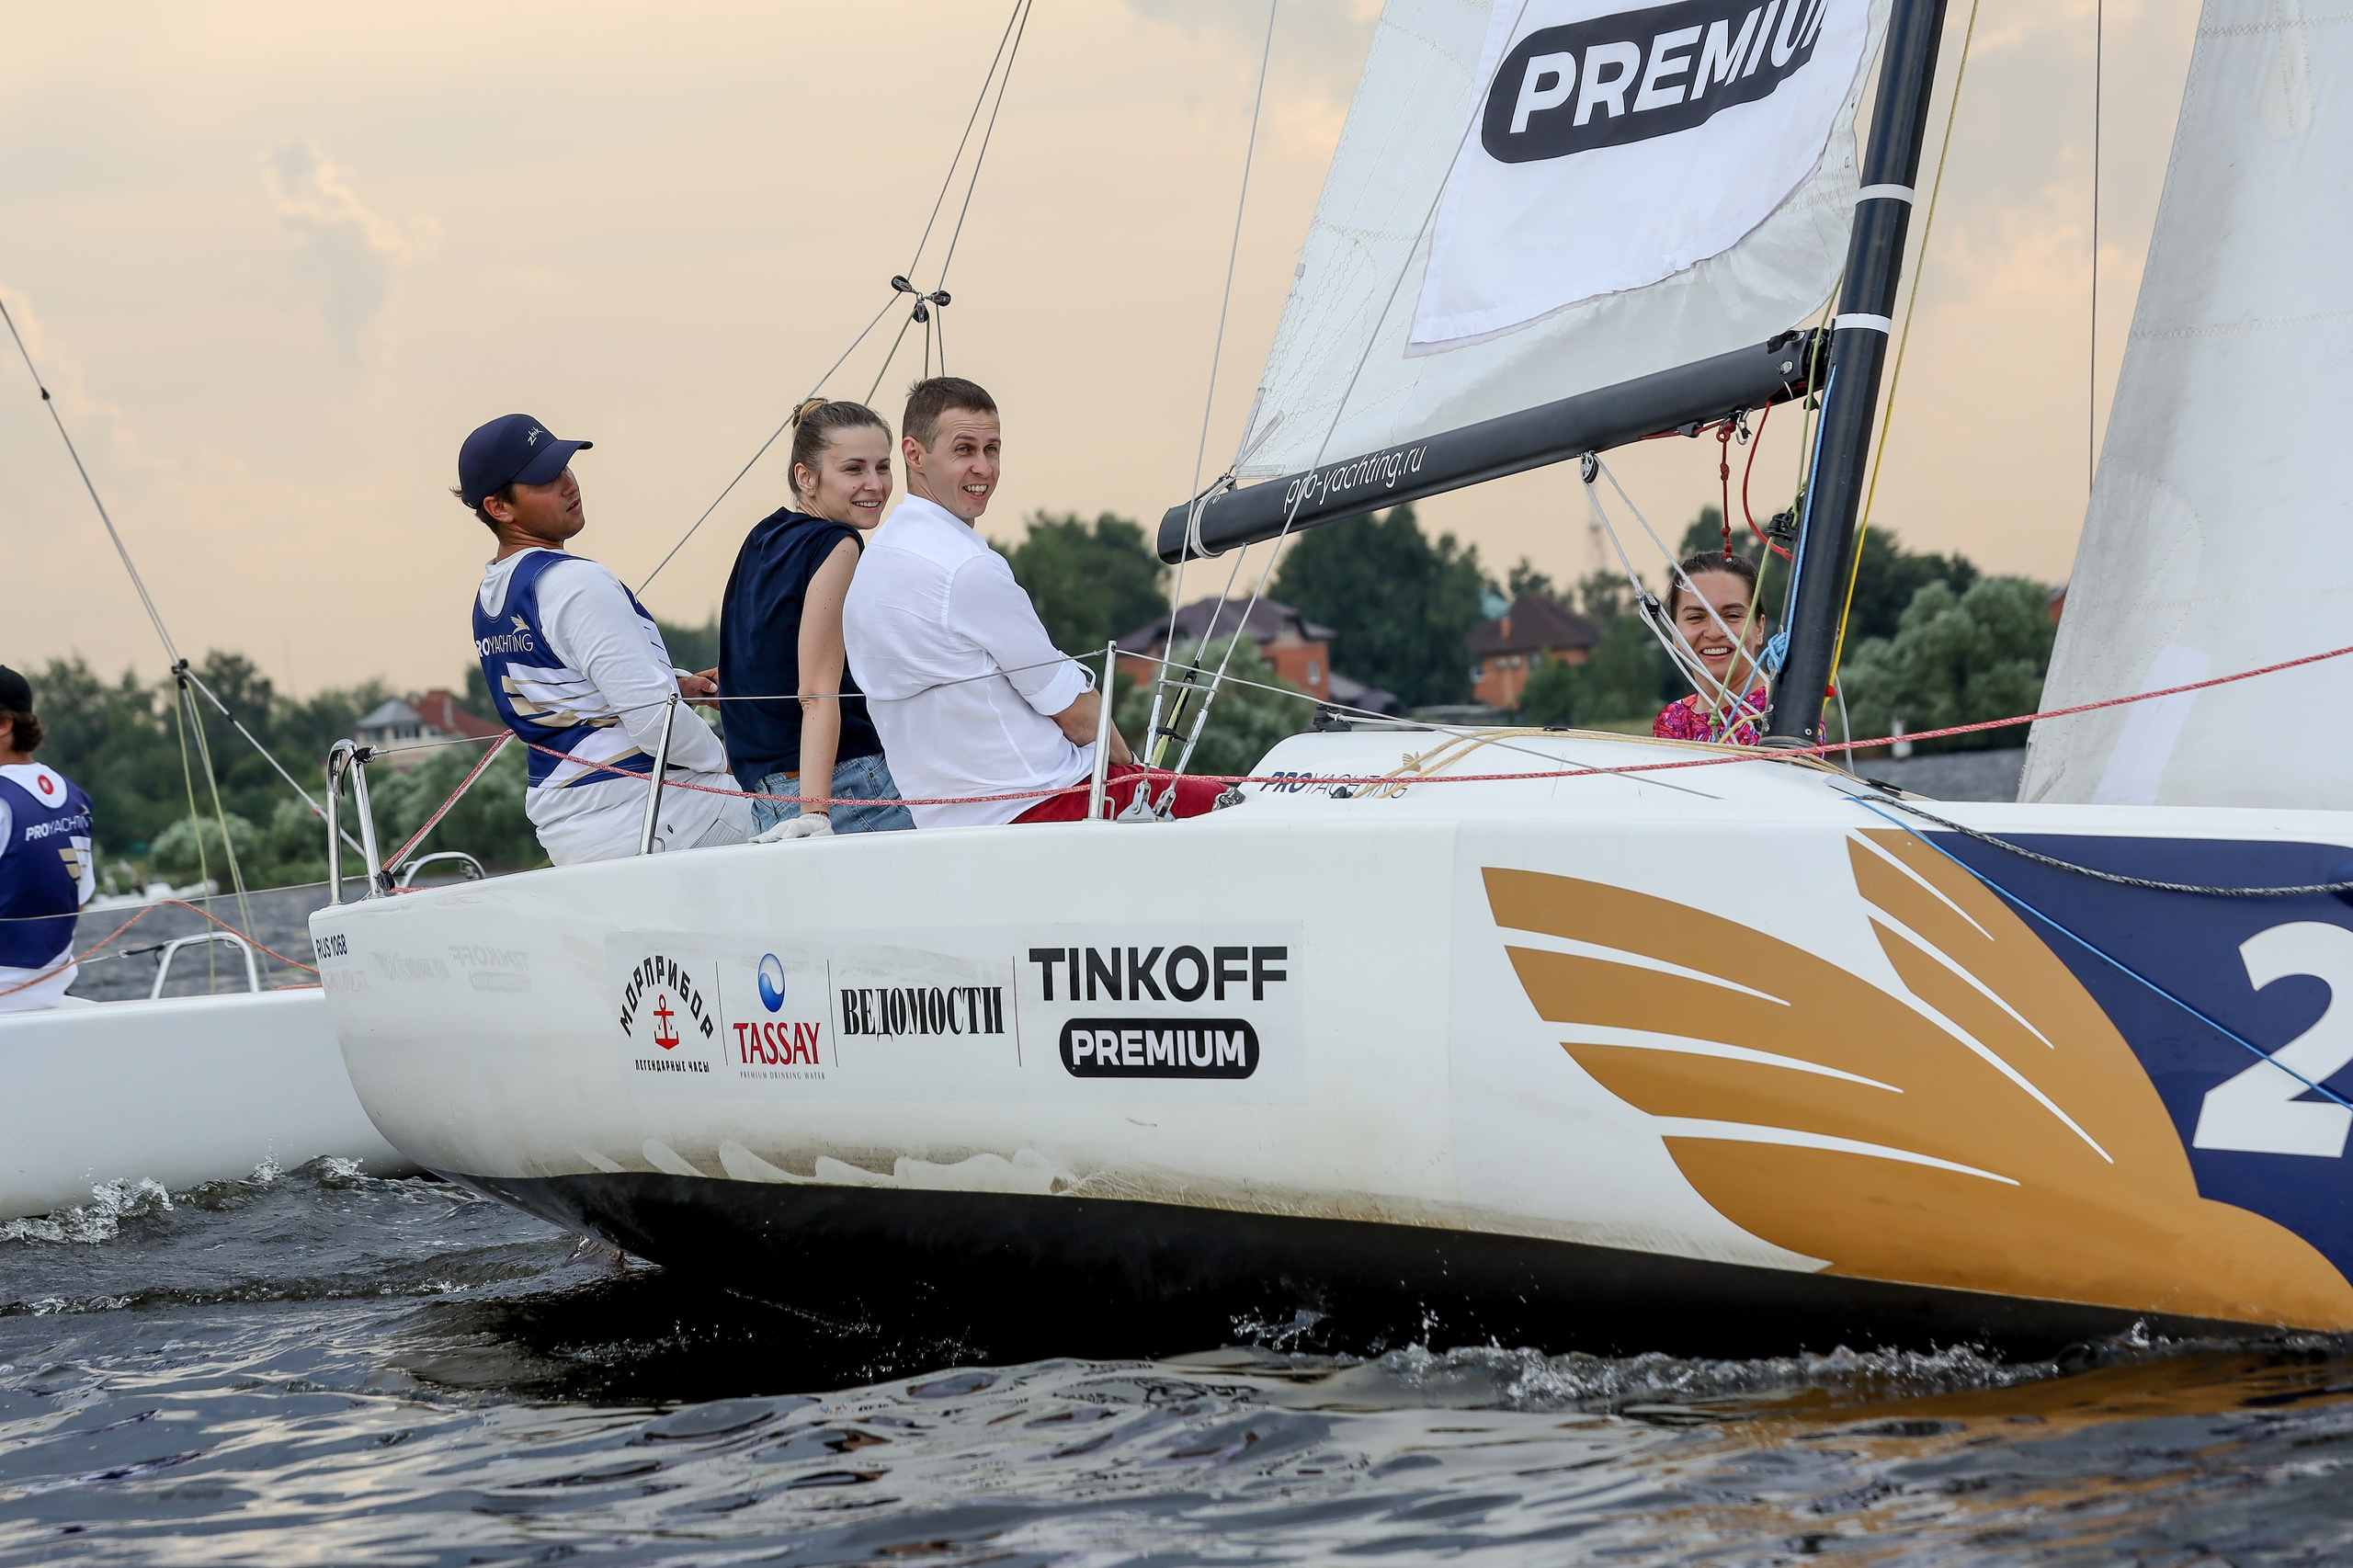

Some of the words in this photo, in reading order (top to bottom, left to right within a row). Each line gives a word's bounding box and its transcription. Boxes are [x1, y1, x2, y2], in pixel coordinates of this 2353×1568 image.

[527, 426, 544, 447] zhik
[1283, 445, 1428, 515] pro-yachting.ru
[475, 633, 534, 658] ROYACHTING
[315, 937, 332, 960] RUS
[331, 933, 347, 957] 1068
[1029, 945, 1288, 1003] TINKOFF
[619, 955, 714, 1040] МОРПРИБОР
[840, 984, 1006, 1043] ВЕДОМОСТИ
[732, 1021, 822, 1065] TASSAY
[1070, 1028, 1247, 1068] PREMIUM
[634, 1059, 687, 1073] ЛЕГЕНДАРНЫЕ
[688, 1061, 710, 1074] ЧАСЫ
[739, 1071, 767, 1079] PREMIUM
[769, 1071, 801, 1080] DRINKING
[803, 1072, 826, 1081] WATER
